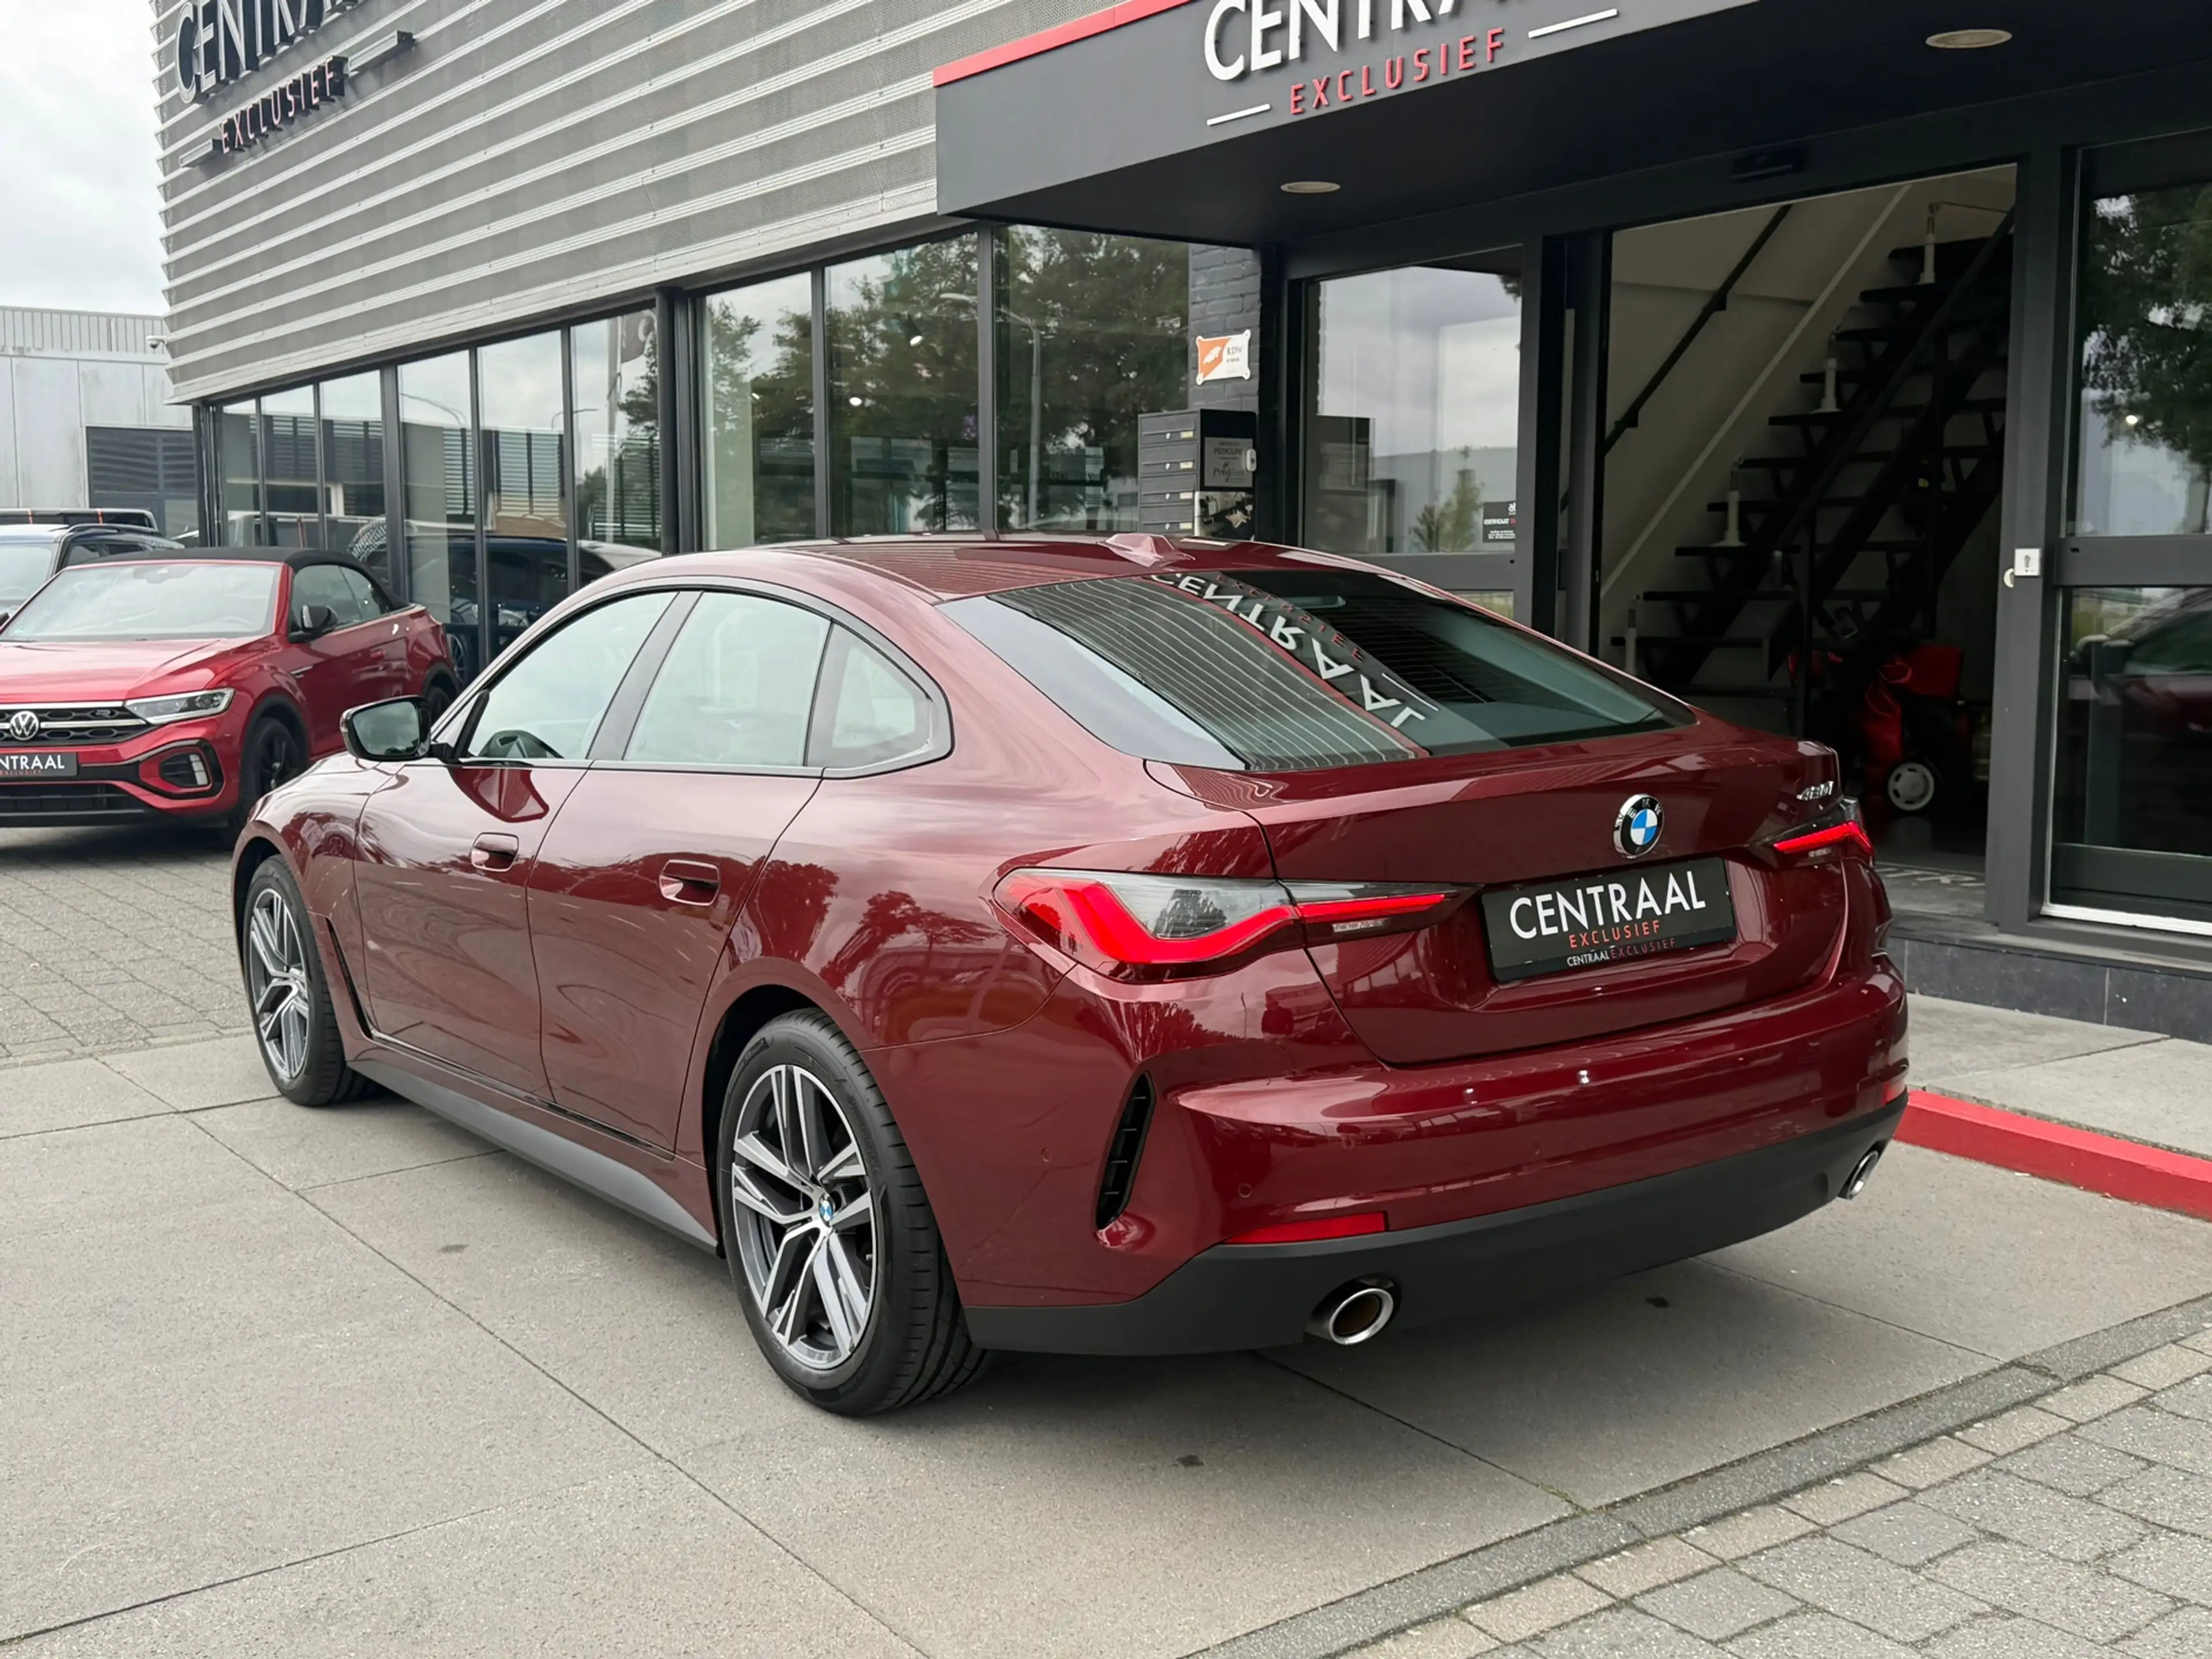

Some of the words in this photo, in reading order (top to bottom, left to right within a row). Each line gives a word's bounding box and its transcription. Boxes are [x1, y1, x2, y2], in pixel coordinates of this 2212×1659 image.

[176, 0, 342, 104] CENT
[1205, 0, 1455, 81] CEN
[1290, 27, 1505, 115] EXCLUSIEF
[221, 56, 335, 154] EXCLUSIEF
[1227, 346, 1242, 355] RDW
[1509, 870, 1706, 939] CENTRAAL
[1569, 920, 1660, 948] EXCLUSIEF
